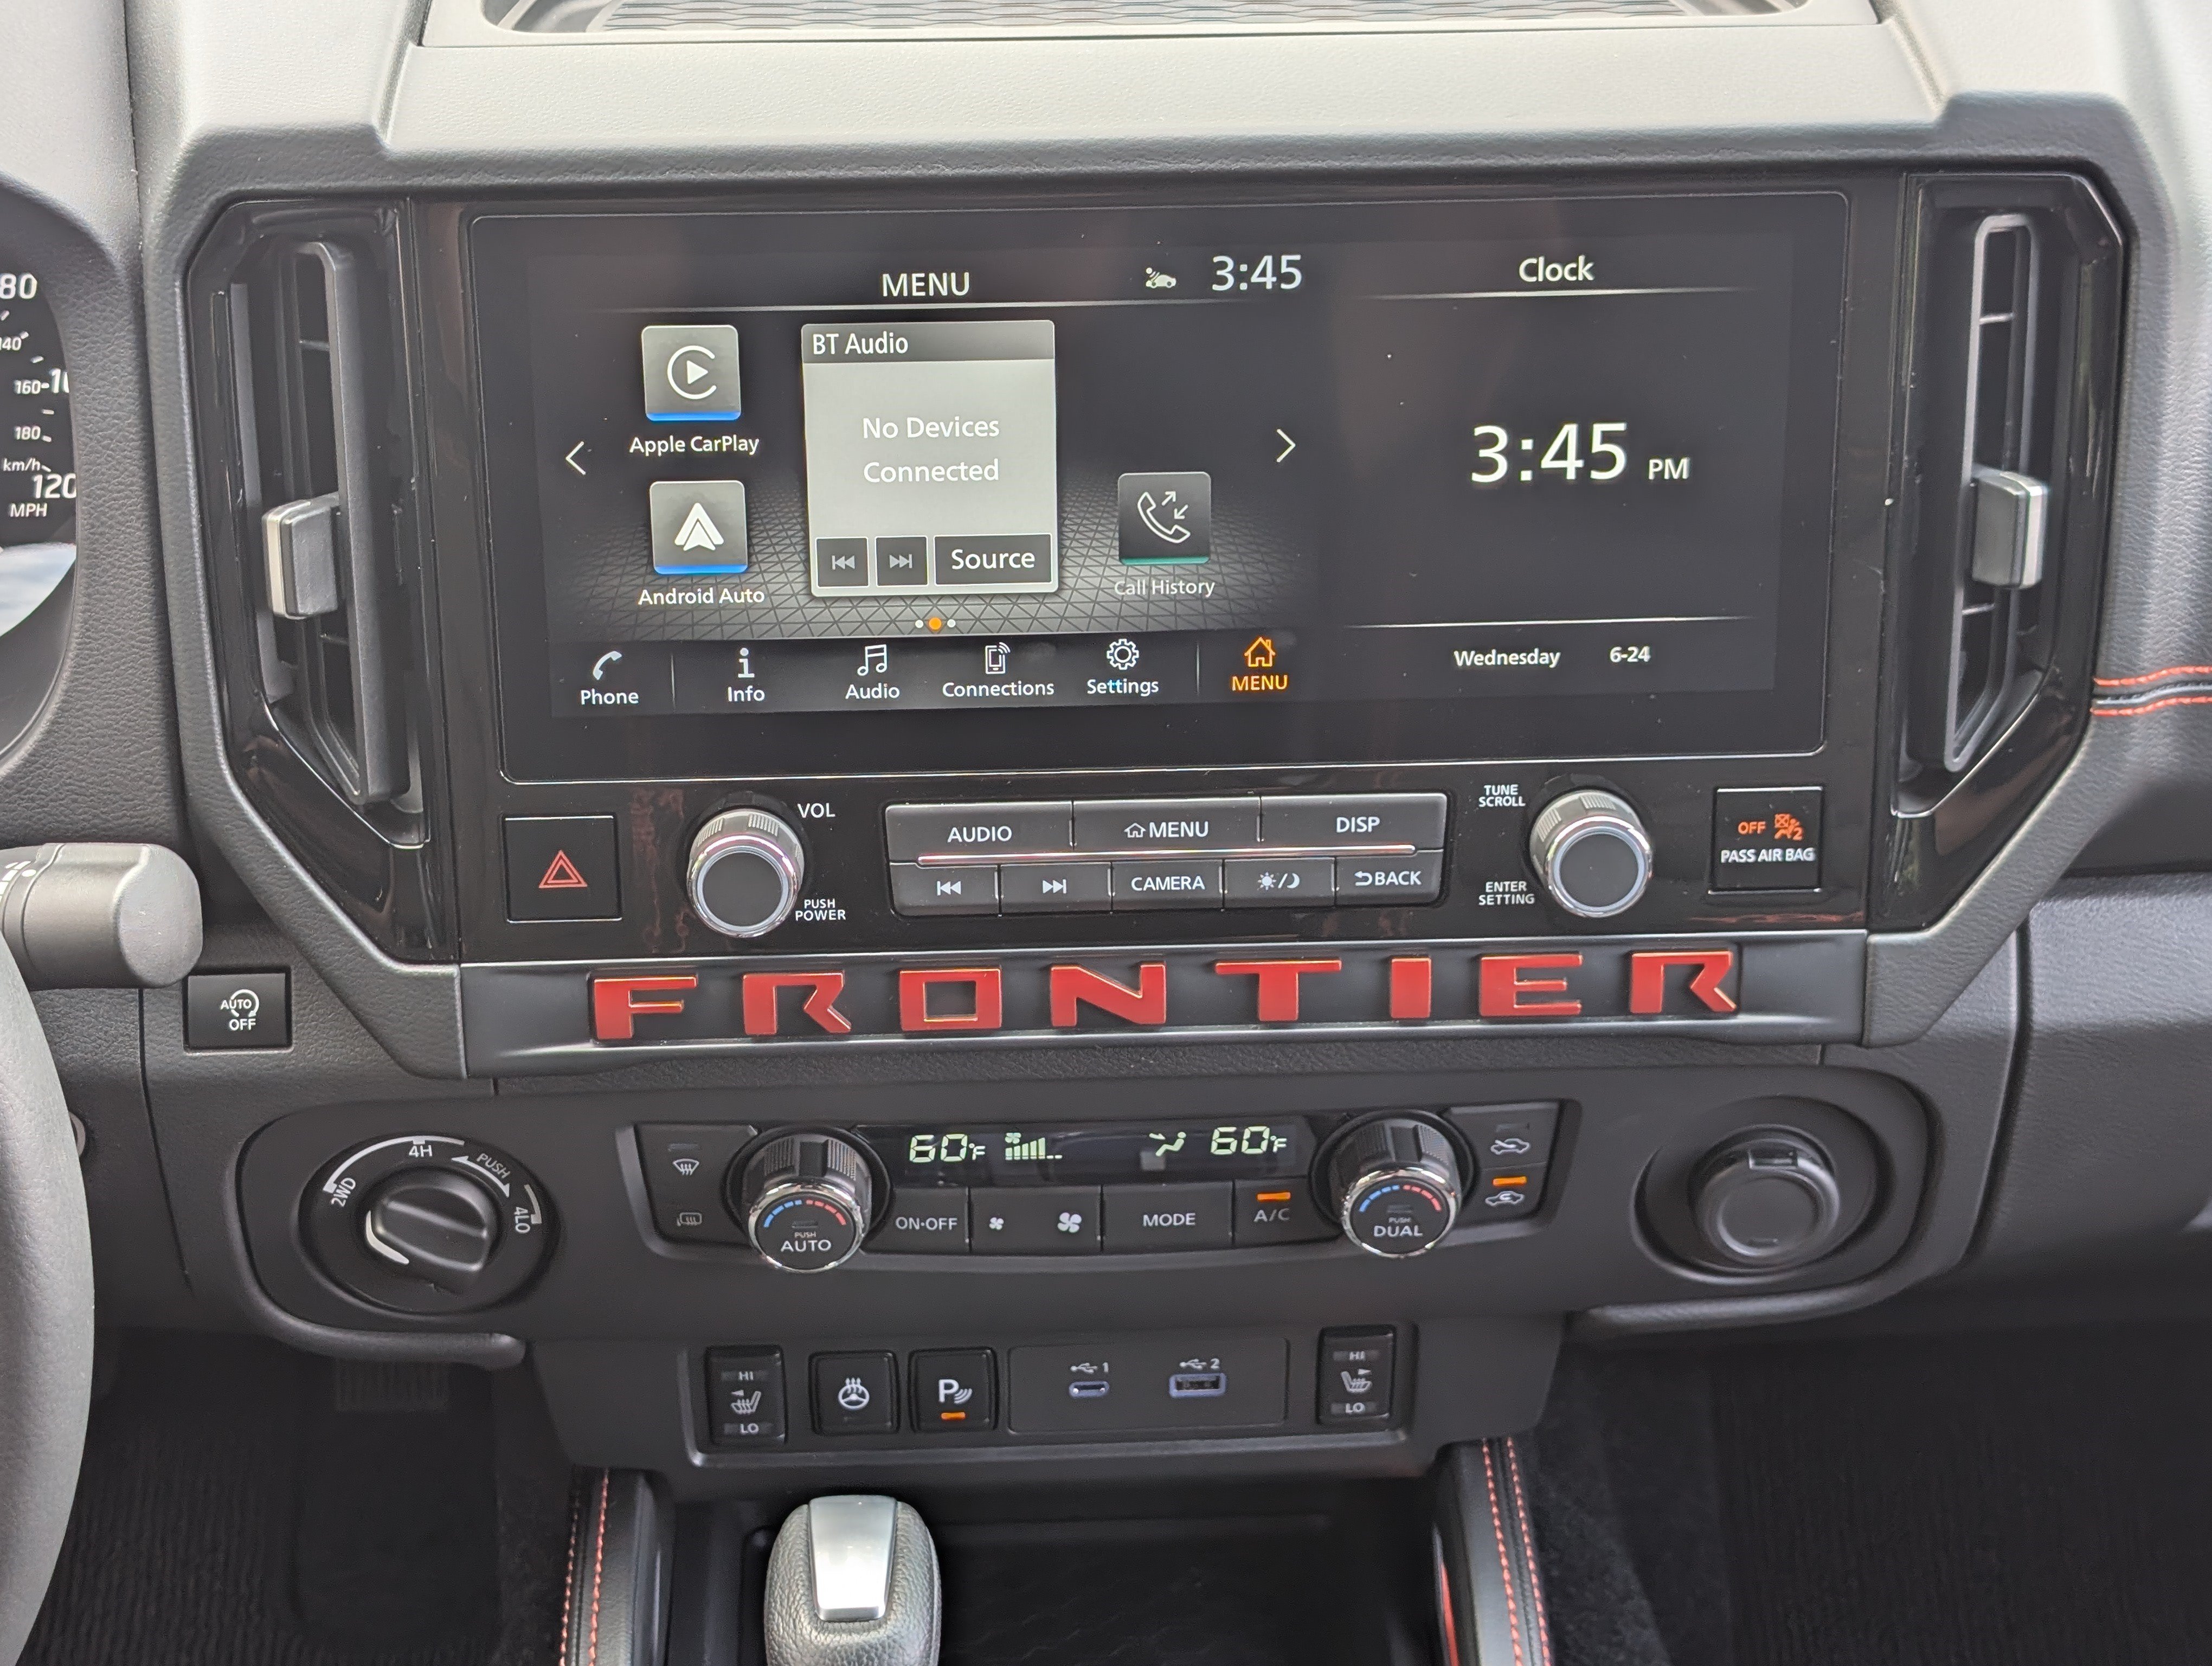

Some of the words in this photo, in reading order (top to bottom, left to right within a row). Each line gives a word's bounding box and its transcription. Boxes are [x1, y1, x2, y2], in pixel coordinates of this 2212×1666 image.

[1211, 254, 1302, 291] 3:45
[1518, 255, 1595, 282] Clock
[0, 273, 37, 299] 80
[881, 272, 971, 298] MENU
[813, 333, 839, 356] BT
[845, 331, 909, 354] Audio
[14, 380, 41, 394] 160
[15, 426, 41, 440] 180
[863, 416, 898, 438] No
[907, 415, 1000, 438] Devices
[629, 435, 685, 457] Apple
[690, 434, 760, 455] CarPlay
[1471, 422, 1628, 483] 3:45
[1648, 458, 1689, 480] PM
[3, 458, 40, 471] km/h
[863, 458, 1000, 483] Connected
[33, 473, 77, 499] 120
[10, 503, 48, 517] MPH
[951, 549, 1036, 570] Source
[1114, 580, 1146, 596] Call
[1152, 579, 1215, 598] History
[638, 588, 713, 606] Android
[719, 588, 765, 604] Auto
[1454, 649, 1561, 669] Wednesday
[1609, 646, 1651, 663] 6-24
[845, 682, 901, 700] Audio
[942, 681, 1055, 697] Connections
[1086, 678, 1160, 696] Settings
[1231, 674, 1288, 692] MENU
[580, 689, 640, 706] Phone
[727, 685, 766, 702] Info
[1484, 785, 1519, 796] TUNE
[797, 802, 836, 818] VOL
[1478, 796, 1526, 808] SCROLL
[1148, 821, 1210, 839] MENU
[1335, 815, 1380, 833] DISP
[1738, 821, 1766, 835] OFF
[947, 825, 1013, 844] AUDIO
[1721, 849, 1757, 863] PASS
[1758, 848, 1783, 862] AIR
[1785, 847, 1816, 862] BAG
[1130, 876, 1205, 892] CAMERA
[1374, 870, 1422, 887] BACK
[1485, 882, 1527, 893] ENTER
[803, 898, 836, 909] PUSH
[1478, 893, 1535, 906] SETTING
[795, 908, 846, 922] POWER
[593, 950, 1738, 1040] FRONTIER
[220, 999, 253, 1010] AUTO
[229, 1018, 256, 1030] OFF
[409, 1144, 433, 1157] 4H
[476, 1152, 511, 1179] PUSH
[330, 1177, 356, 1207] 2WD
[1143, 1213, 1195, 1227] MODE
[1254, 1208, 1290, 1222] A/C
[1374, 1225, 1423, 1238] DUAL
[781, 1239, 832, 1253] AUTO
[1211, 1358, 1220, 1370] 2
[1349, 1351, 1365, 1361] HI
[1102, 1362, 1109, 1373] 1
[738, 1372, 754, 1381] HI
[1345, 1402, 1366, 1413] LO
[740, 1423, 759, 1435] LO
